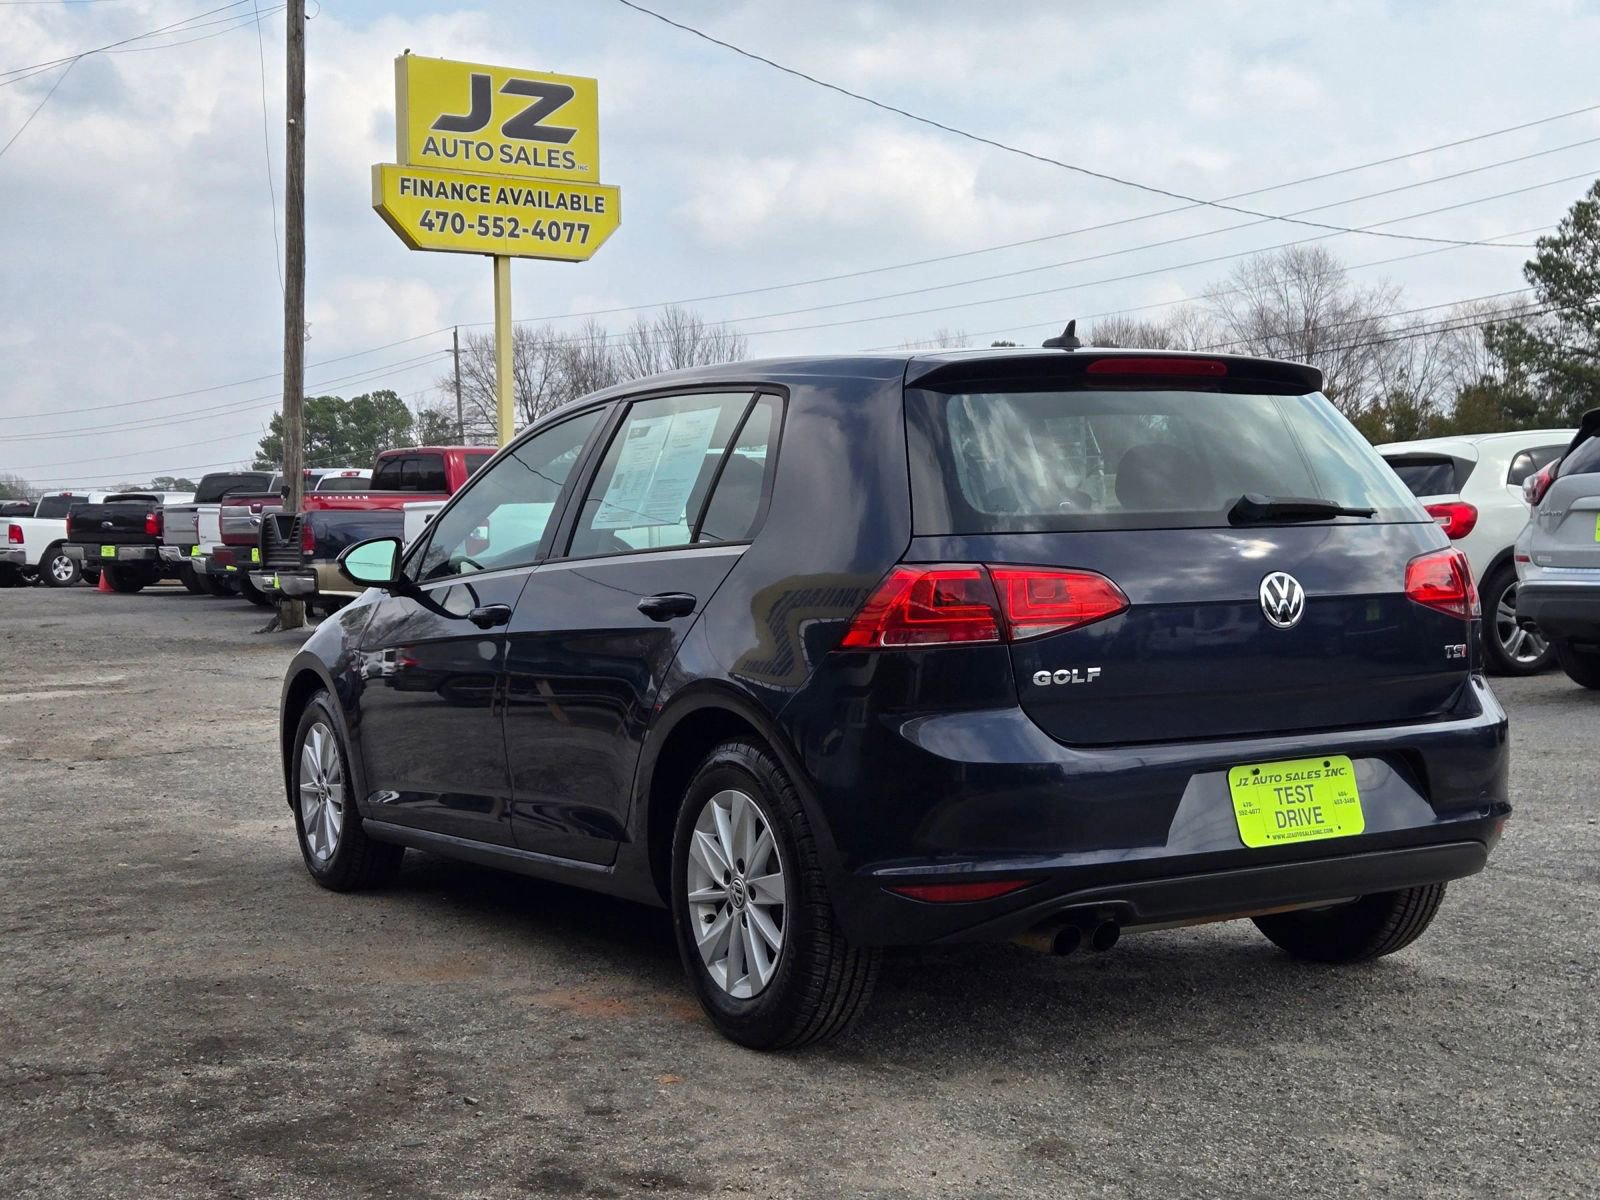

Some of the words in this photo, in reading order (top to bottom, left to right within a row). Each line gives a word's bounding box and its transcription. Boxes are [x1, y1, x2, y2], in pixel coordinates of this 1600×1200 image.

[431, 74, 577, 144] JZ
[422, 136, 494, 162] AUTO
[500, 144, 576, 170] SALES
[400, 178, 491, 204] FINANCE
[496, 187, 605, 214] AVAILABLE
[420, 210, 590, 244] 470-552-4077
[1444, 644, 1466, 659] TSI
[1033, 667, 1101, 686] GOLF
[1236, 778, 1249, 787] JZ
[1252, 774, 1282, 785] AUTO
[1285, 770, 1321, 782] SALES
[1324, 767, 1347, 778] INC.
[1273, 784, 1314, 806] TEST
[1275, 806, 1325, 829] DRIVE
